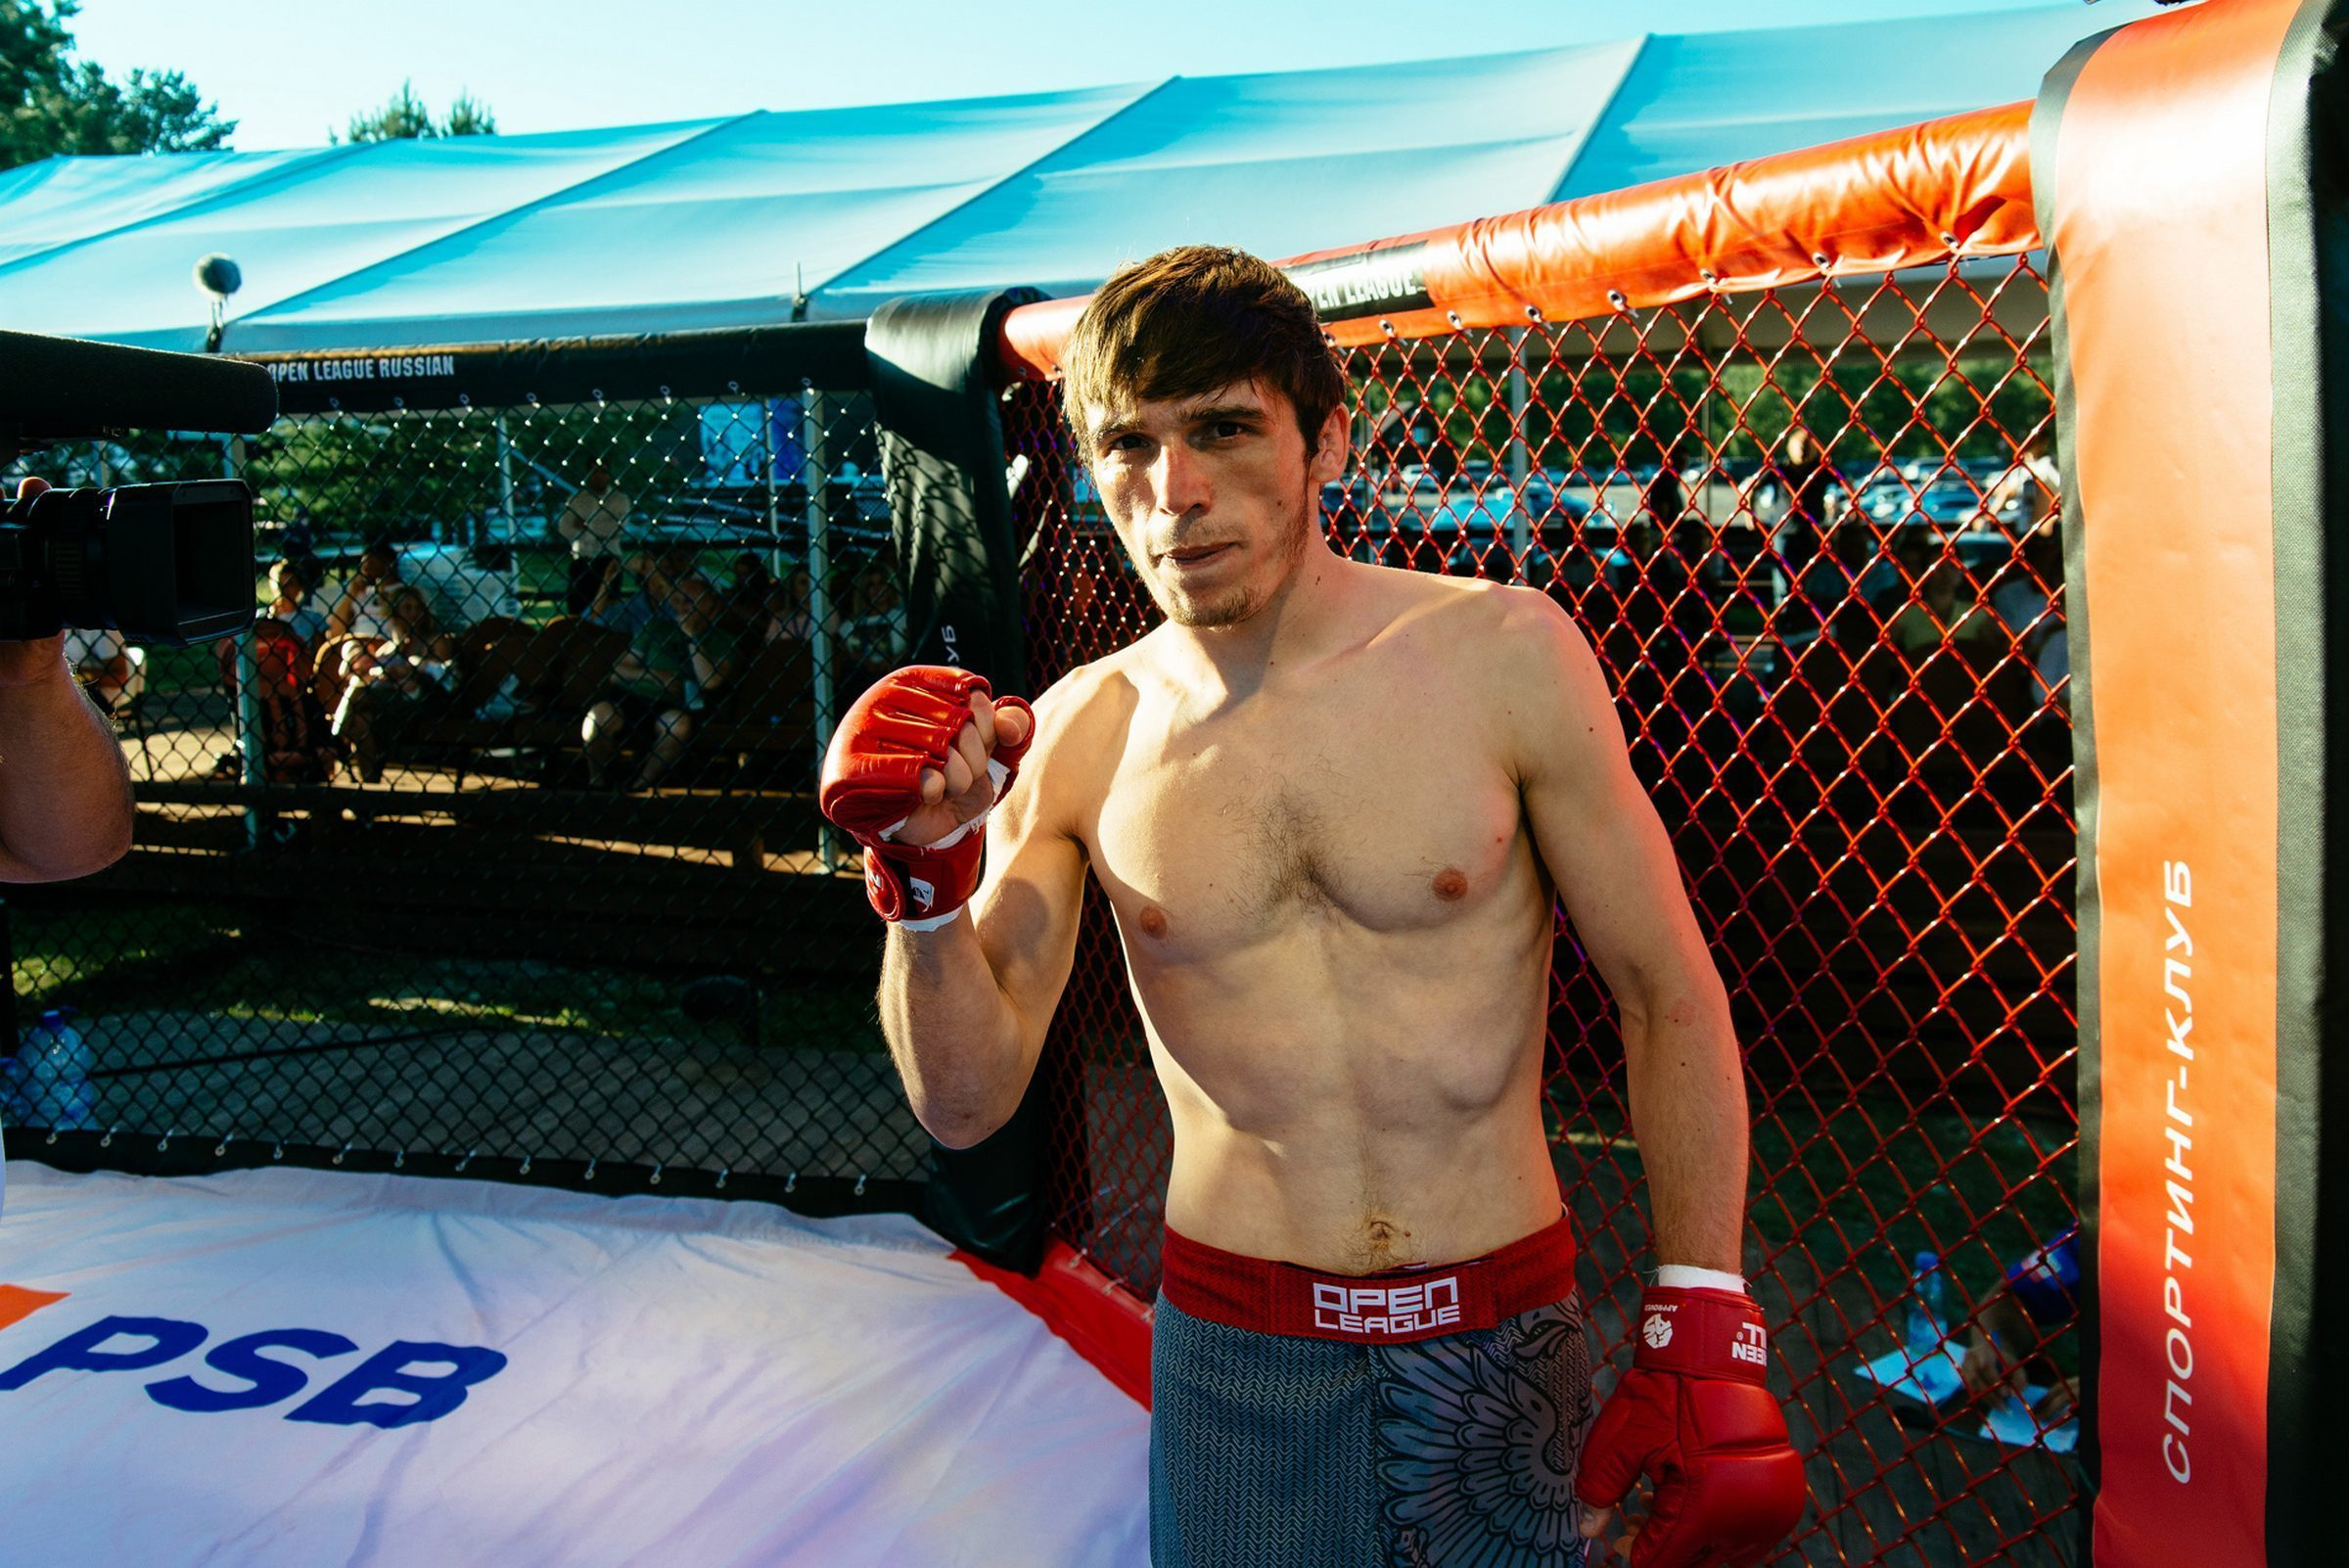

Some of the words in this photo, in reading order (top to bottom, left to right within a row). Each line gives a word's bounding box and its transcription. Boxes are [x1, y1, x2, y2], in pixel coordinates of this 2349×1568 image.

[1344, 265, 1418, 305] LEAGUE
[313, 357, 375, 381] LEAGUE
[379, 354, 455, 379] RUSSIAN
[942, 624, 960, 669] УБ
[2163, 859, 2194, 1484] СПОРТИНГ-КЛУБ
[1313, 1276, 1458, 1314] OPEN
[1314, 1305, 1460, 1334] LEAGUE
[0, 1314, 508, 1429] PSB
